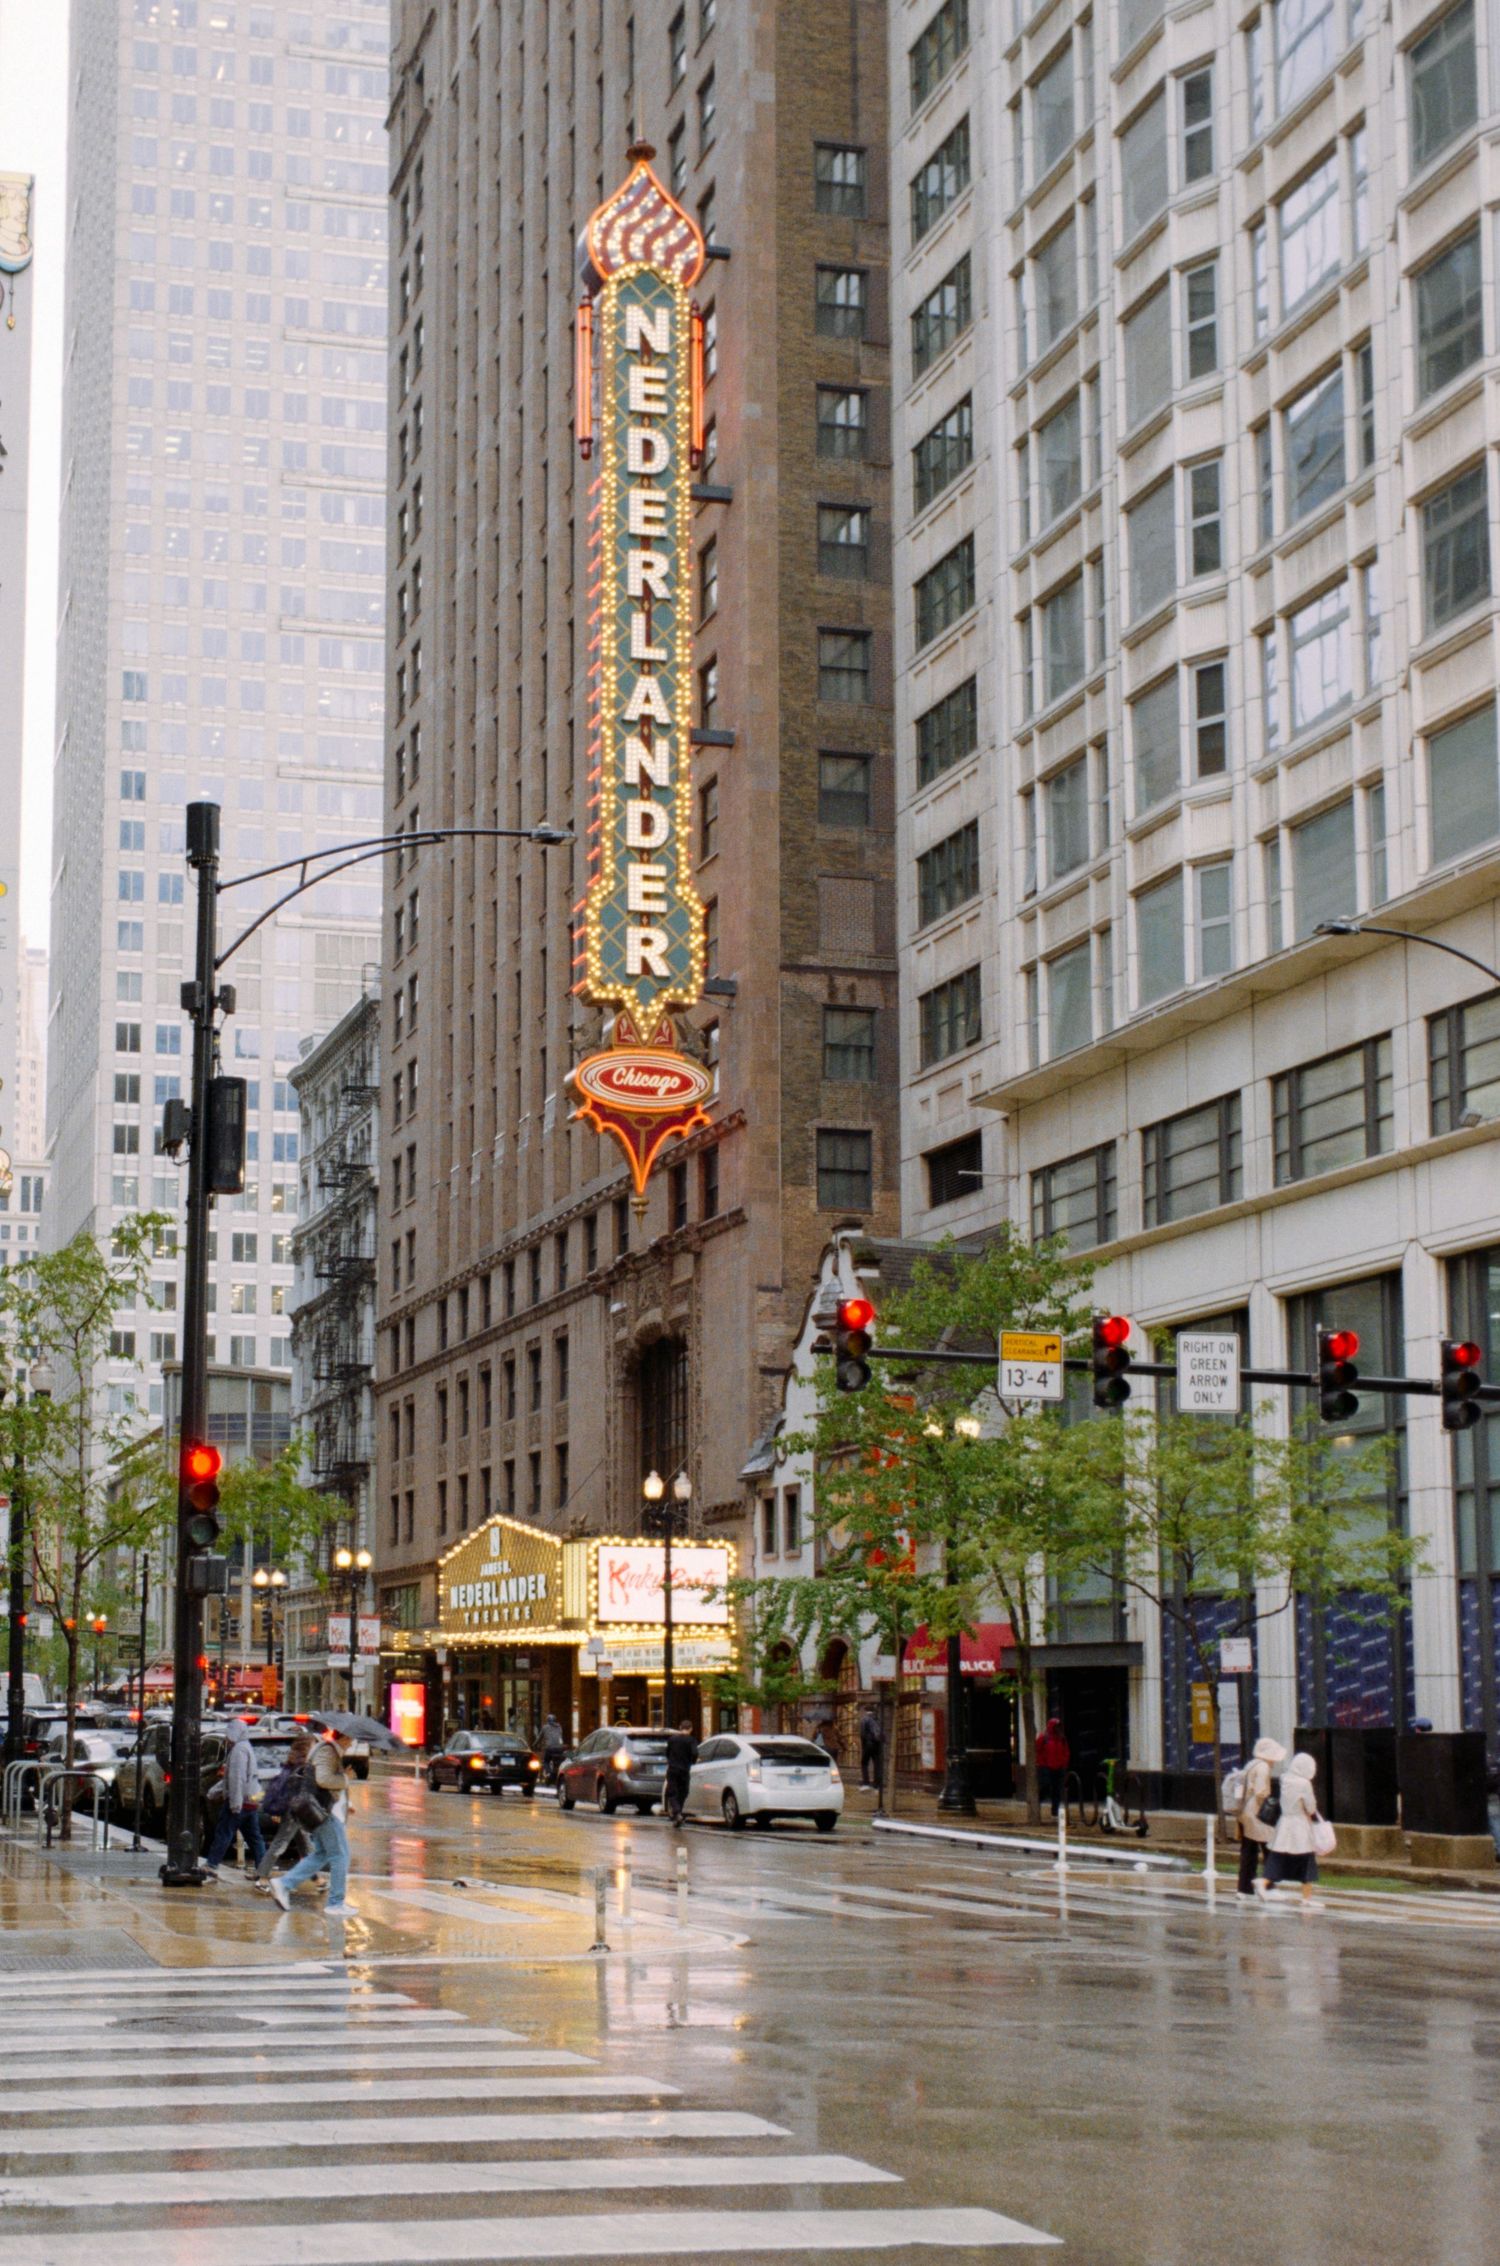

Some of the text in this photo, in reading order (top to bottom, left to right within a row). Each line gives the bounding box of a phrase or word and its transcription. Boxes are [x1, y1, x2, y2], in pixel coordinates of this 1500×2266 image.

[622, 304, 672, 978] NEDERLANDER
[612, 1066, 681, 1096] Chicago
[1005, 1338, 1037, 1346] VERTICAL
[1183, 1340, 1234, 1354] RIGHT ON
[1004, 1347, 1044, 1356] CLEARANCE
[1190, 1358, 1227, 1371] GREEN
[1189, 1374, 1228, 1387] ARROW
[1193, 1391, 1223, 1404] ONLY
[450, 1573, 547, 1609] NEDERLANDER
[464, 1605, 532, 1625] THEATRE
[960, 1660, 996, 1672] BLICK
